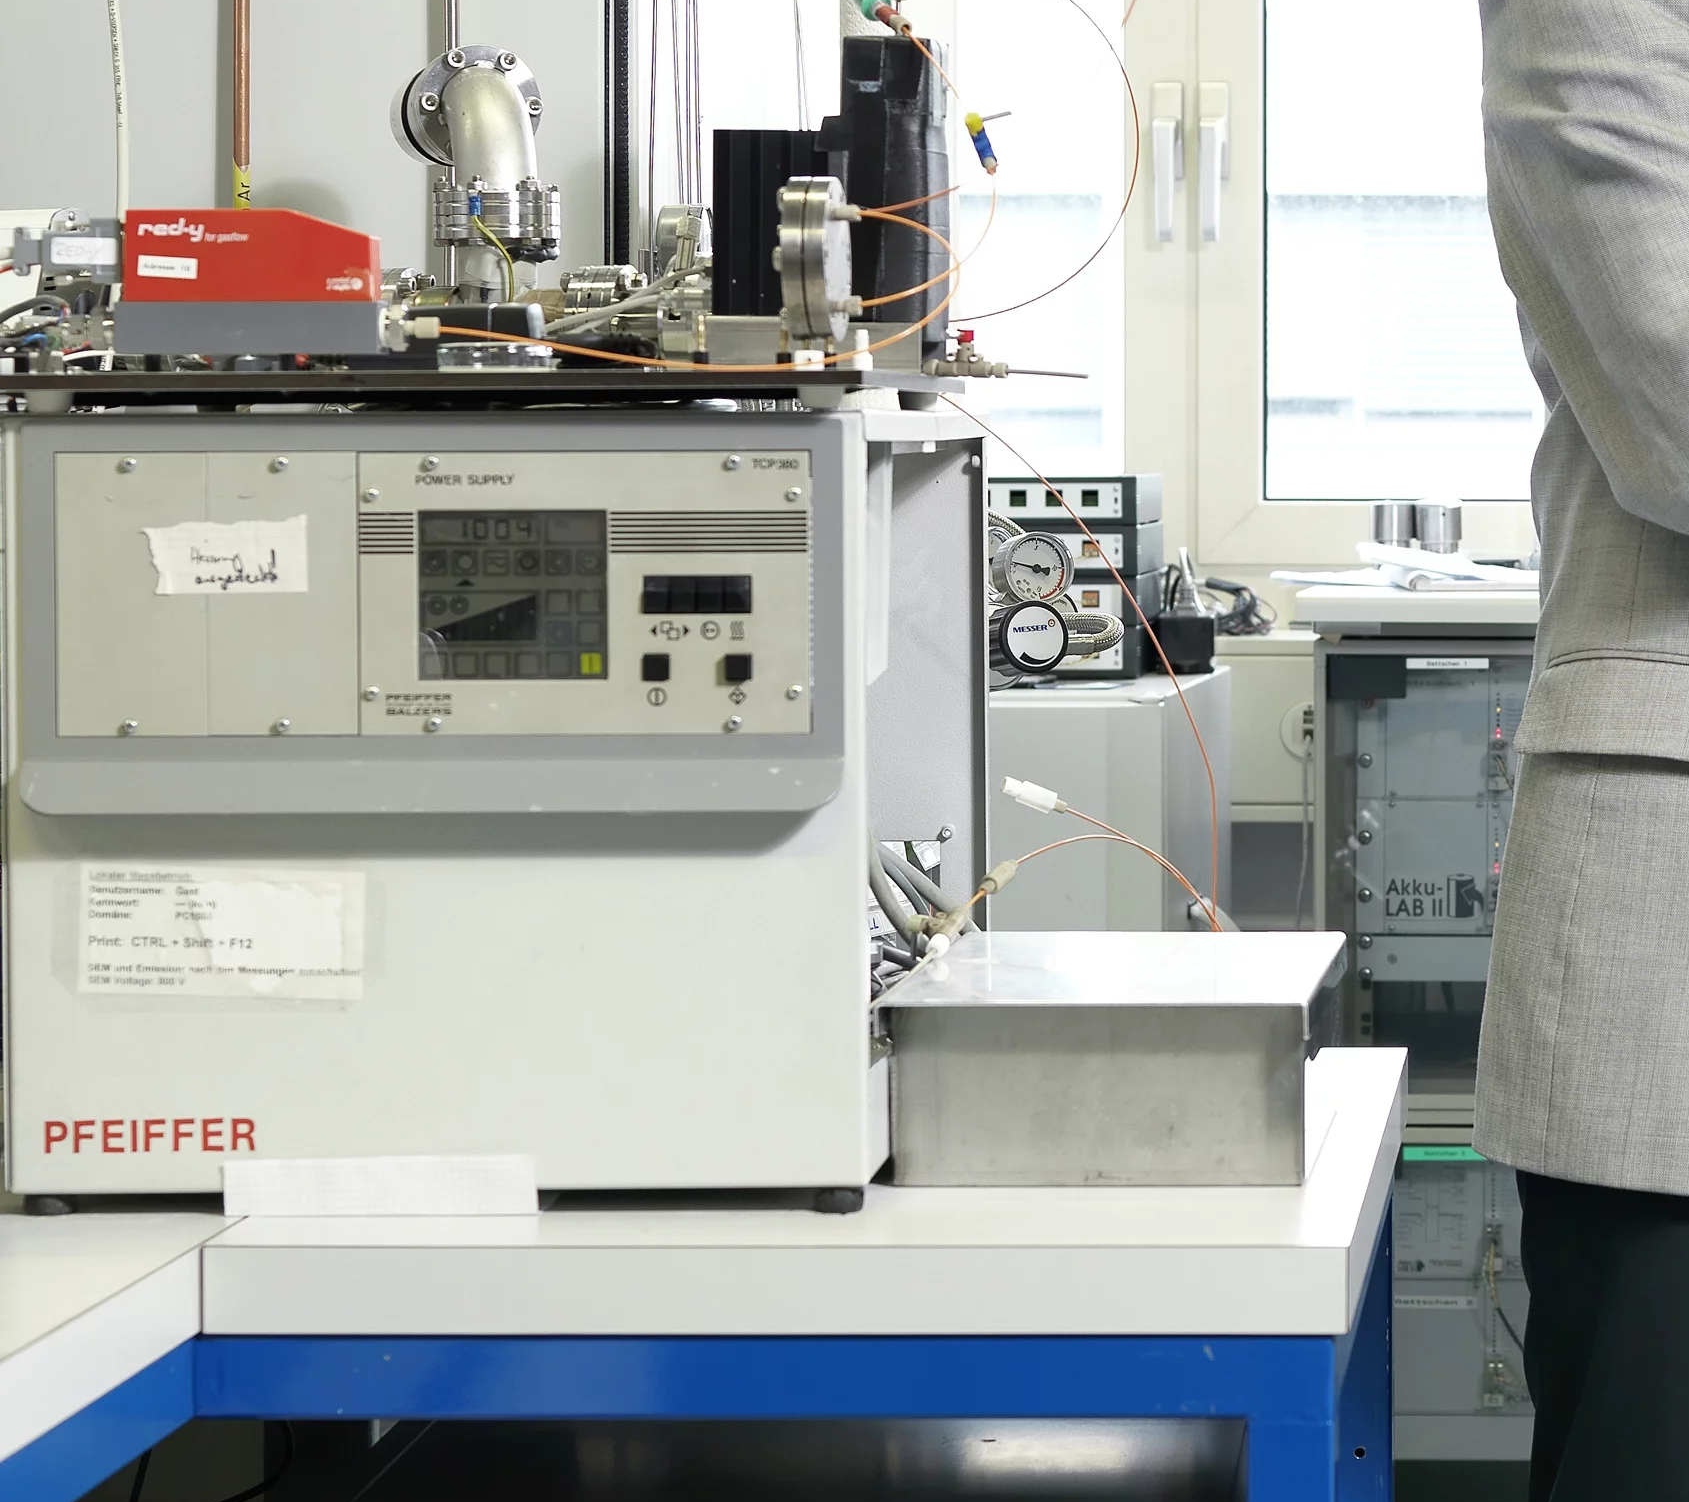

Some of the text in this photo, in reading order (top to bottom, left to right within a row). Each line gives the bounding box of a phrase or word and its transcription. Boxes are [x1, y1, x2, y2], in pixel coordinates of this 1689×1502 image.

[238, 182, 250, 201] Ar
[414, 474, 515, 486] POWER SUPPLY
[1012, 625, 1047, 634] MESSER
[1386, 878, 1443, 896] Akku-
[1386, 899, 1424, 917] LAB
[88, 936, 124, 947] Print:
[131, 936, 167, 948] CTRL
[229, 937, 253, 949] F12
[43, 1117, 256, 1154] PFEIFFER
